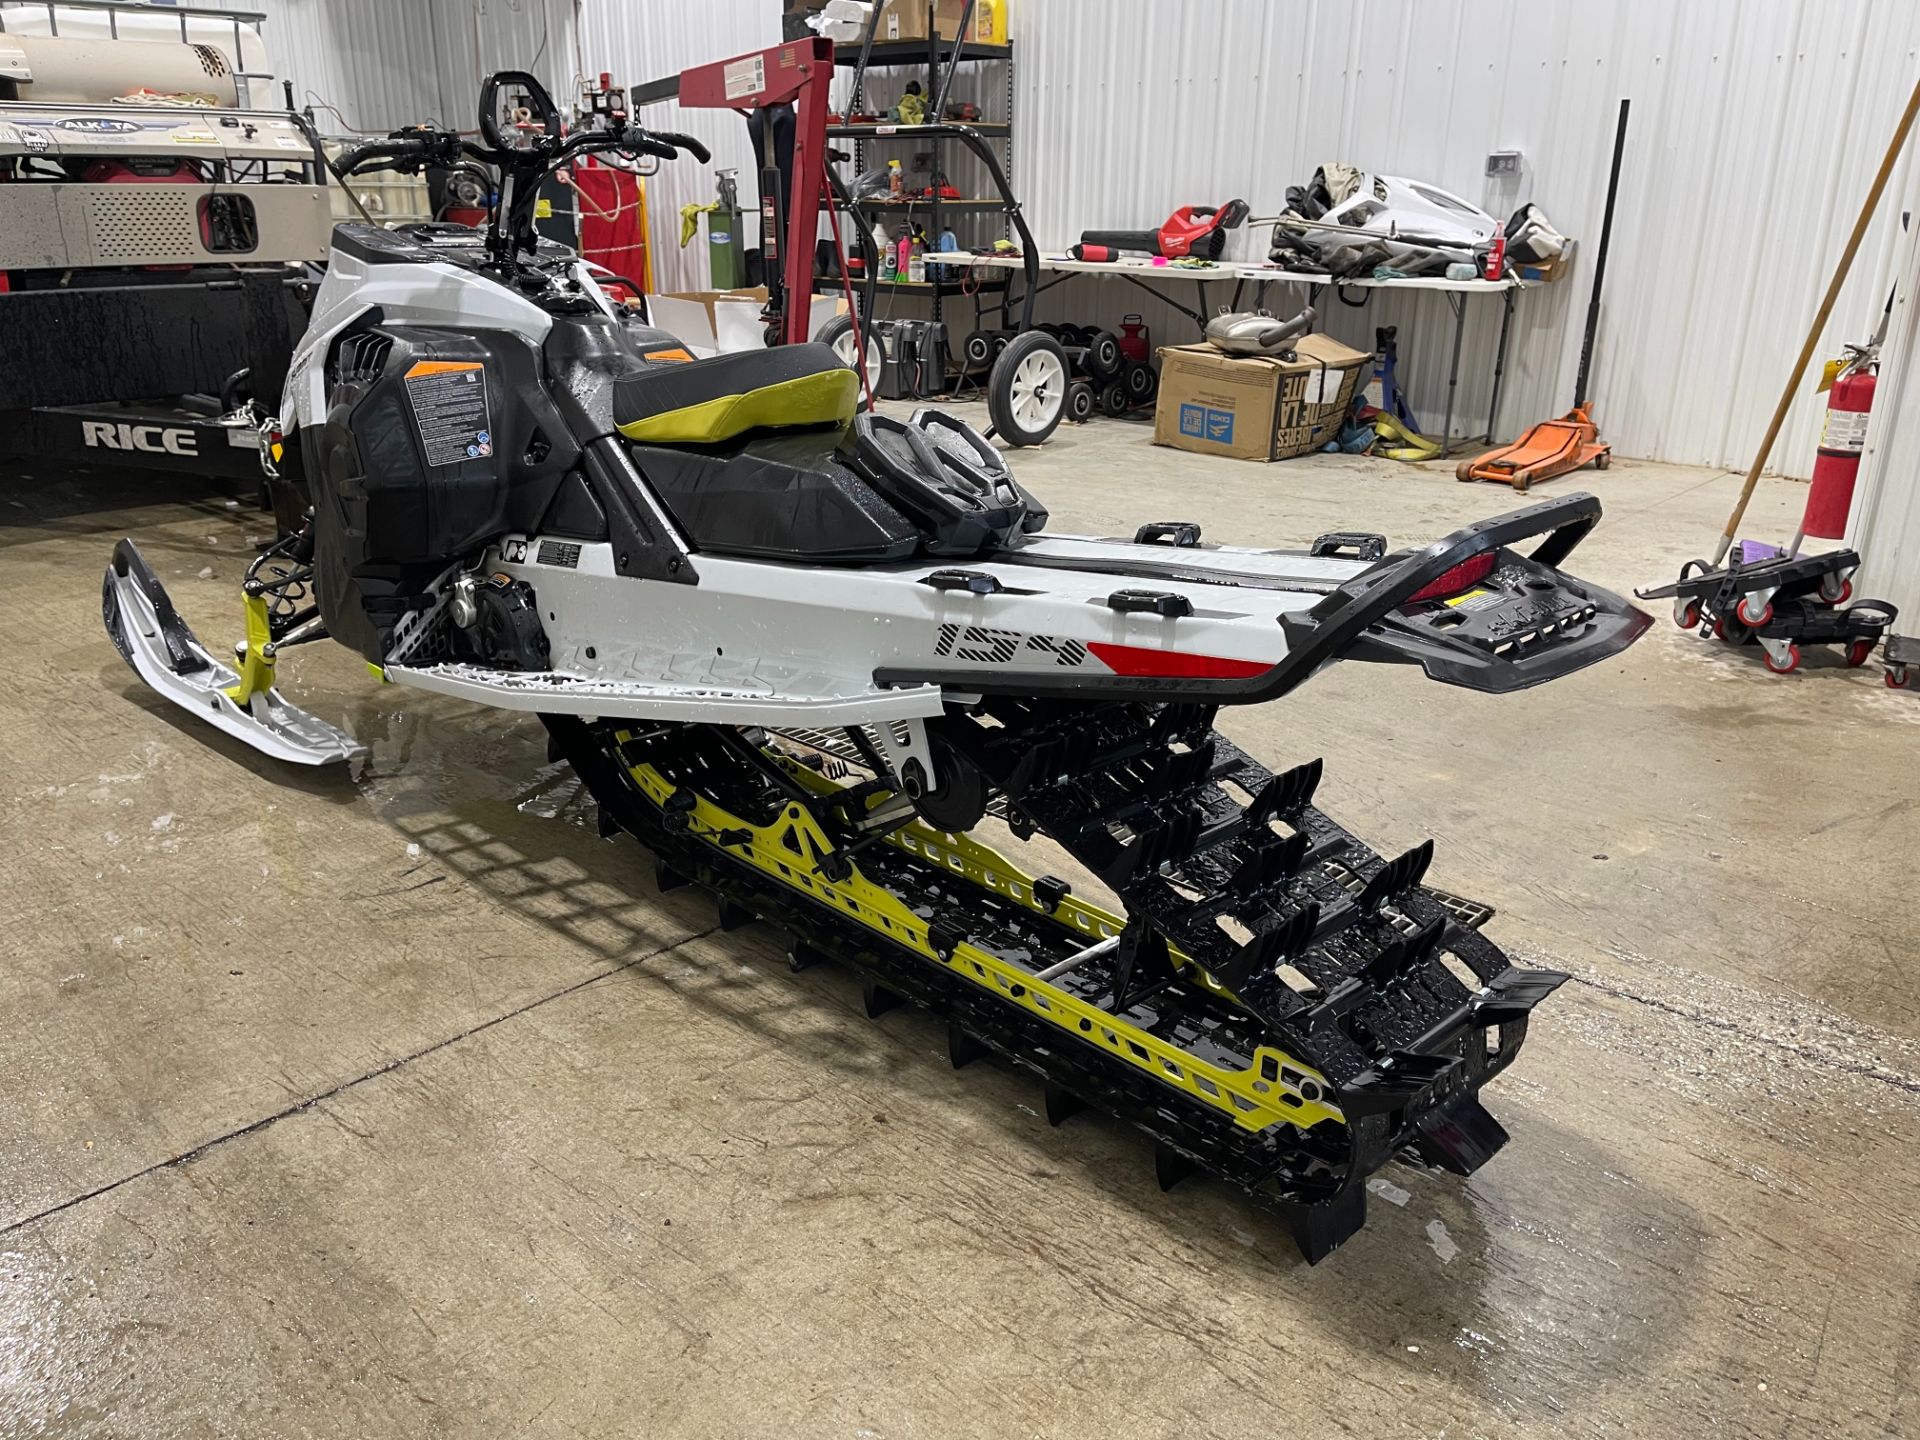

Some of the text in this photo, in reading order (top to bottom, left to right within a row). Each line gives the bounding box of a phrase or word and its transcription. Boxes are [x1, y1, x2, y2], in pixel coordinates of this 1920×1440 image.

[1282, 376, 1309, 402] UTE
[1280, 401, 1300, 428] LA
[82, 421, 199, 457] RICE
[934, 623, 1087, 667] 154
